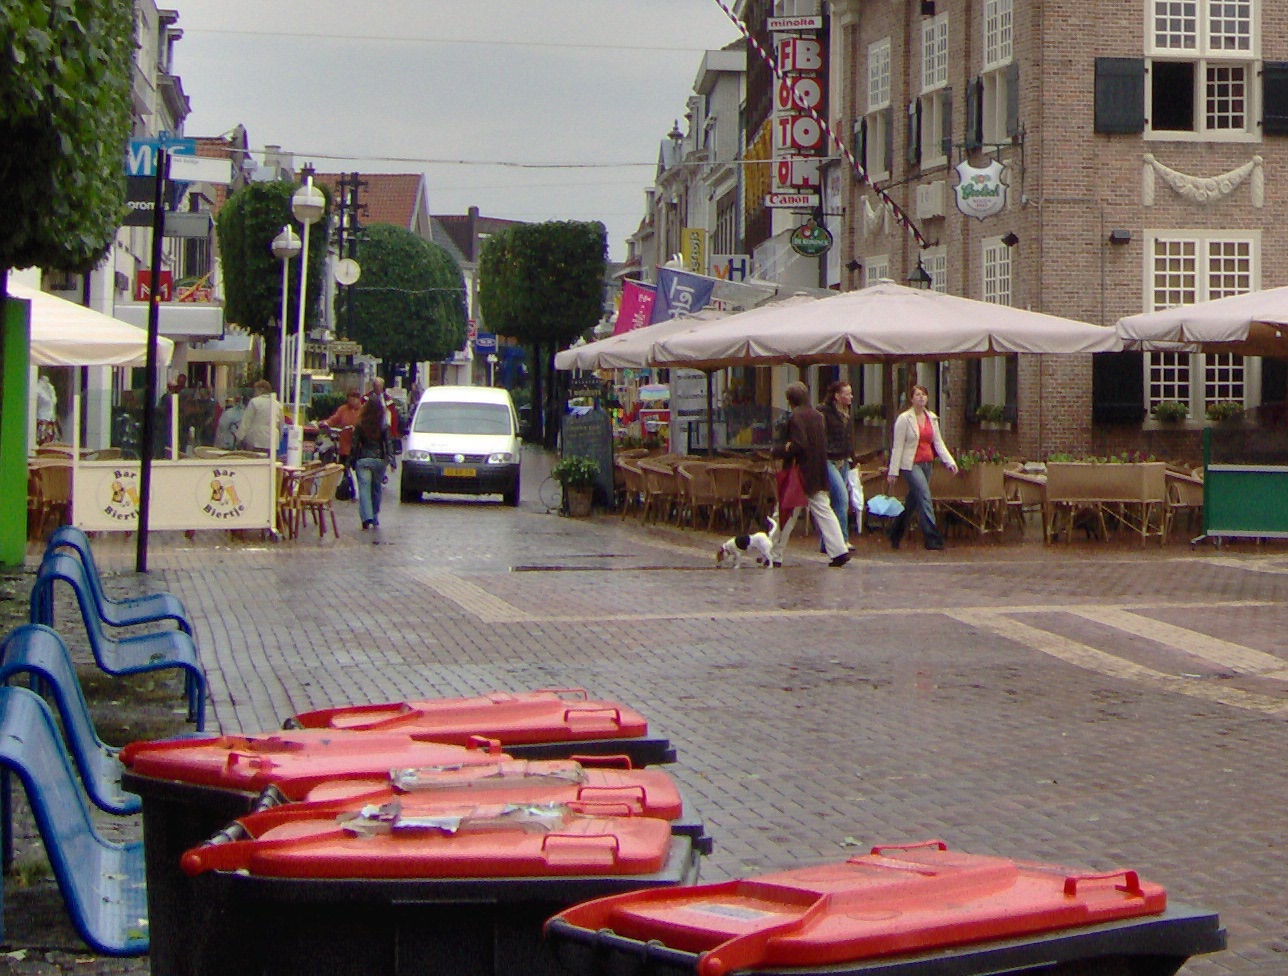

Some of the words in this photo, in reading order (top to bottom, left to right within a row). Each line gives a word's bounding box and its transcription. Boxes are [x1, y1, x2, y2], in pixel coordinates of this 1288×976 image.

[114, 470, 137, 479] Bar
[213, 469, 236, 477] Bar
[104, 505, 139, 520] Biert
[203, 503, 245, 519] Biertje
